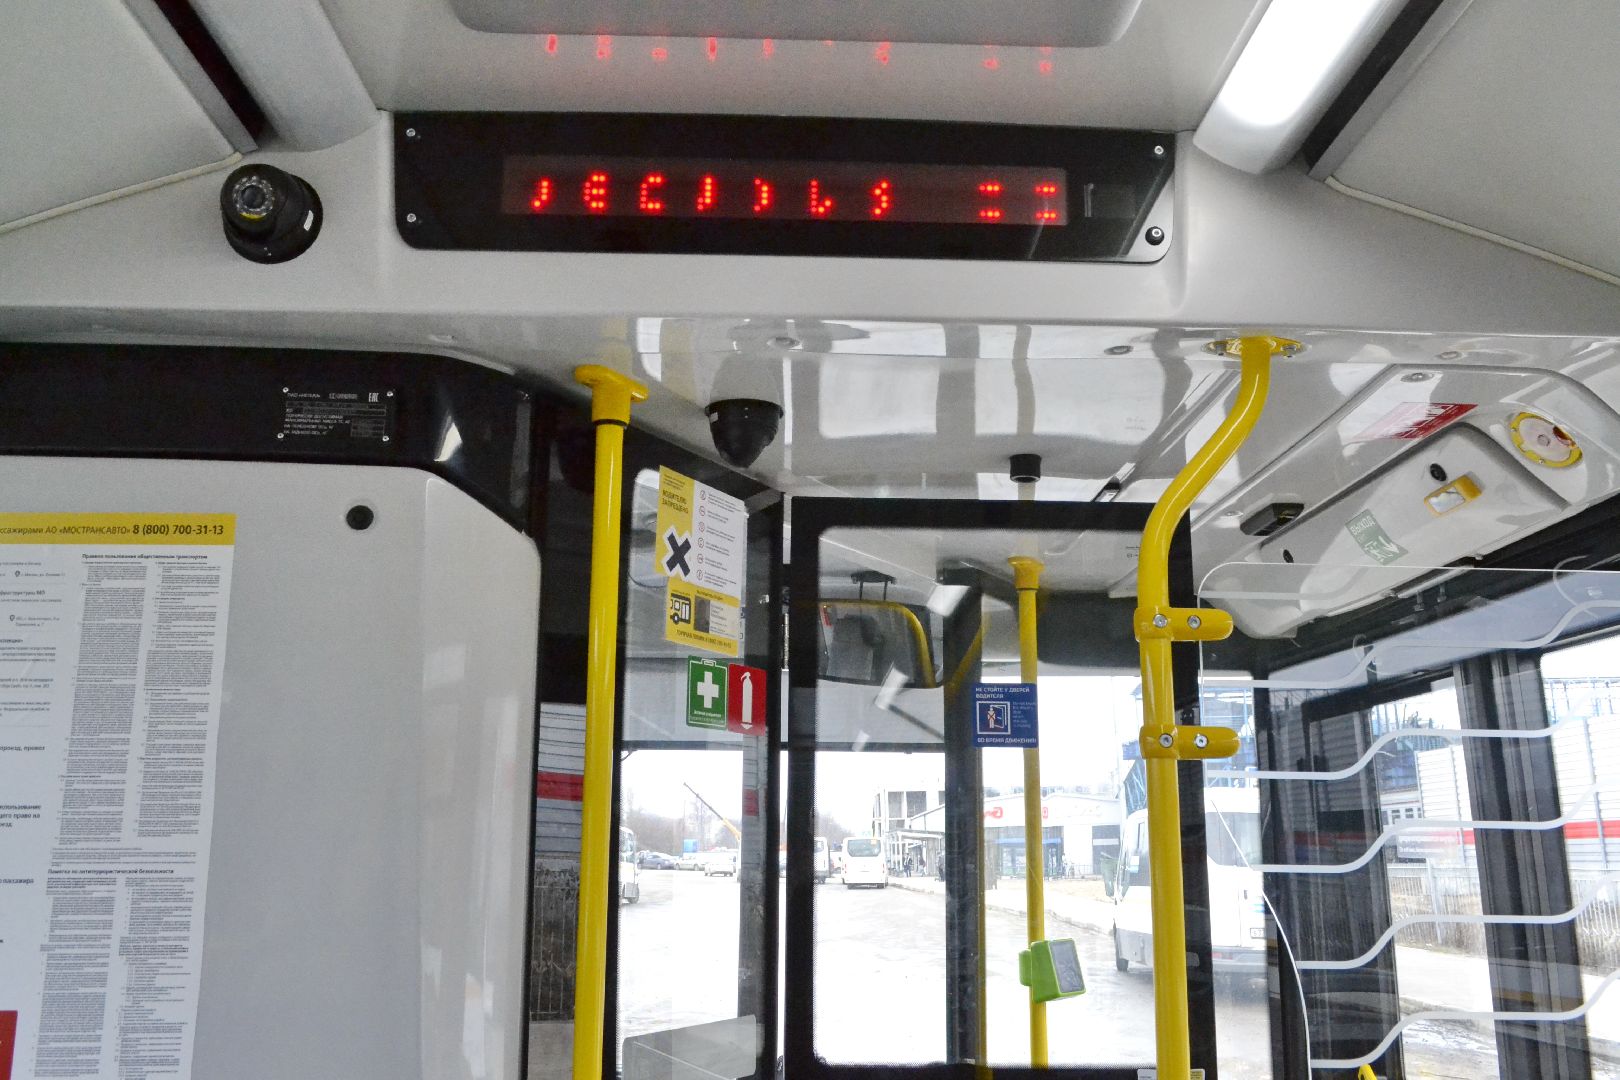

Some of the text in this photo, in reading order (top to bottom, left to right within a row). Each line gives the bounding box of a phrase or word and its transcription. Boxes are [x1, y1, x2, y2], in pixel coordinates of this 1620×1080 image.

[45, 525, 58, 535] АО
[132, 524, 140, 535] 8
[142, 524, 170, 536] (800)
[172, 524, 224, 535] 700-31-13
